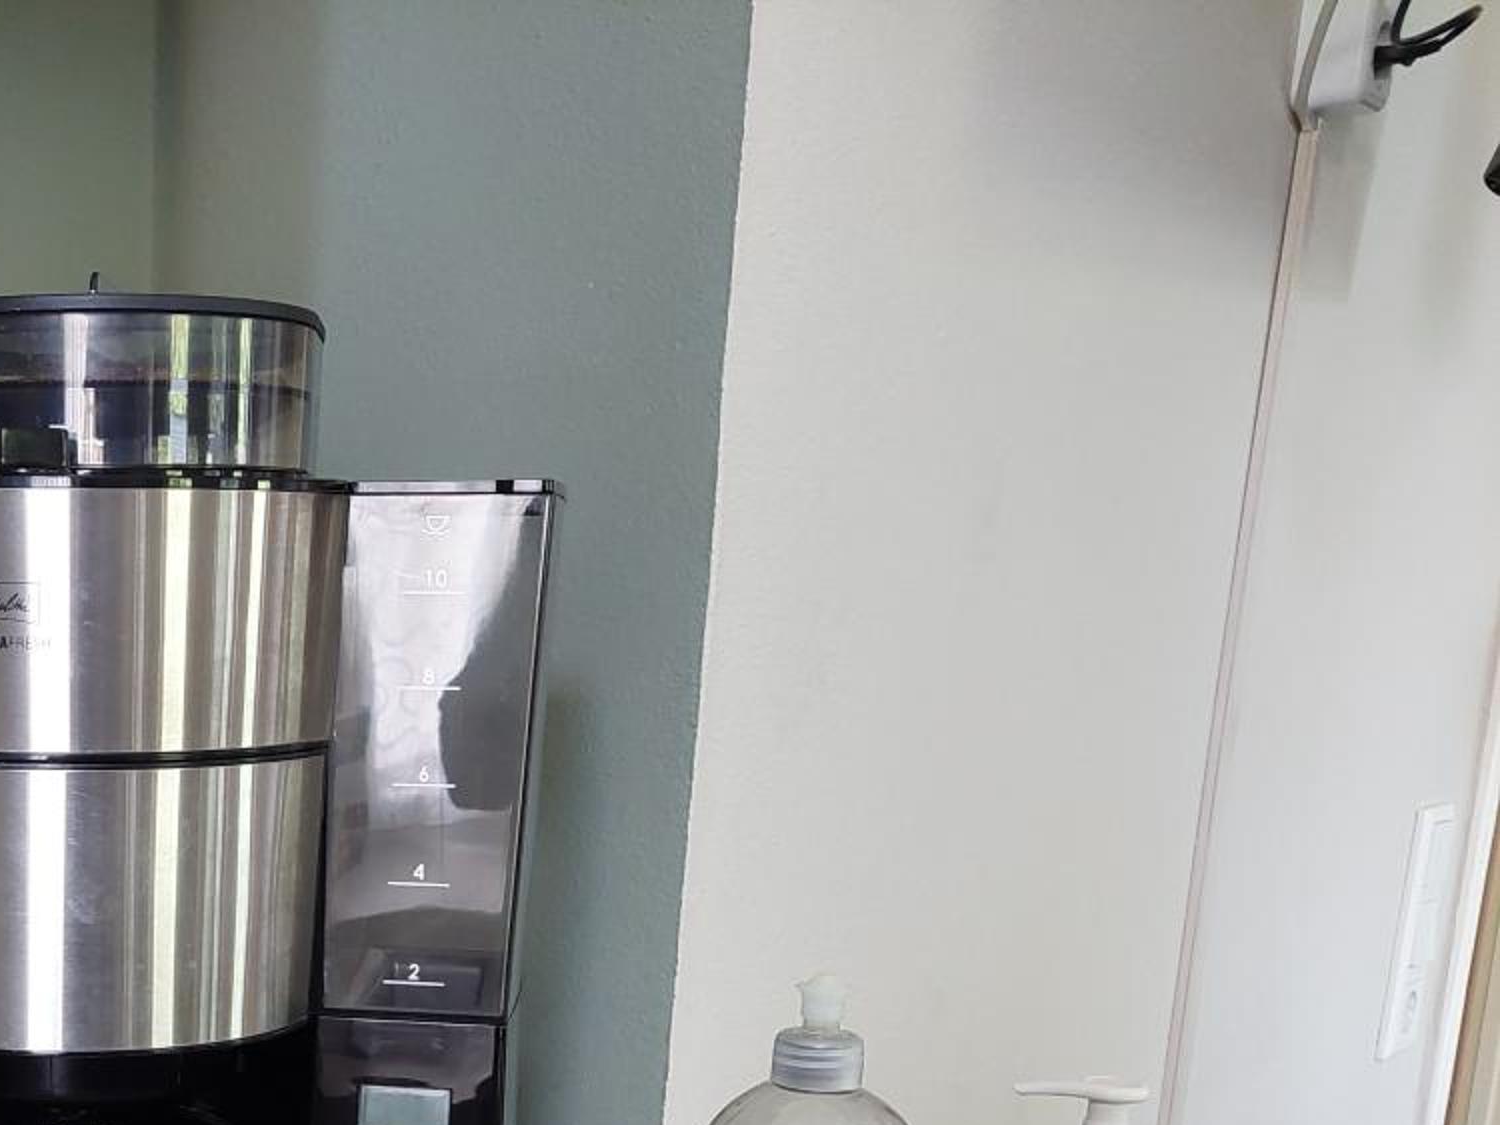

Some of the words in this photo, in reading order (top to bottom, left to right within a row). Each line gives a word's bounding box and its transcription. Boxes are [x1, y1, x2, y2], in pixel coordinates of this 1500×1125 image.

[423, 570, 448, 589] 10
[422, 668, 436, 686] 8
[418, 767, 430, 783] 6
[412, 864, 426, 881] 4
[407, 964, 421, 981] 2
